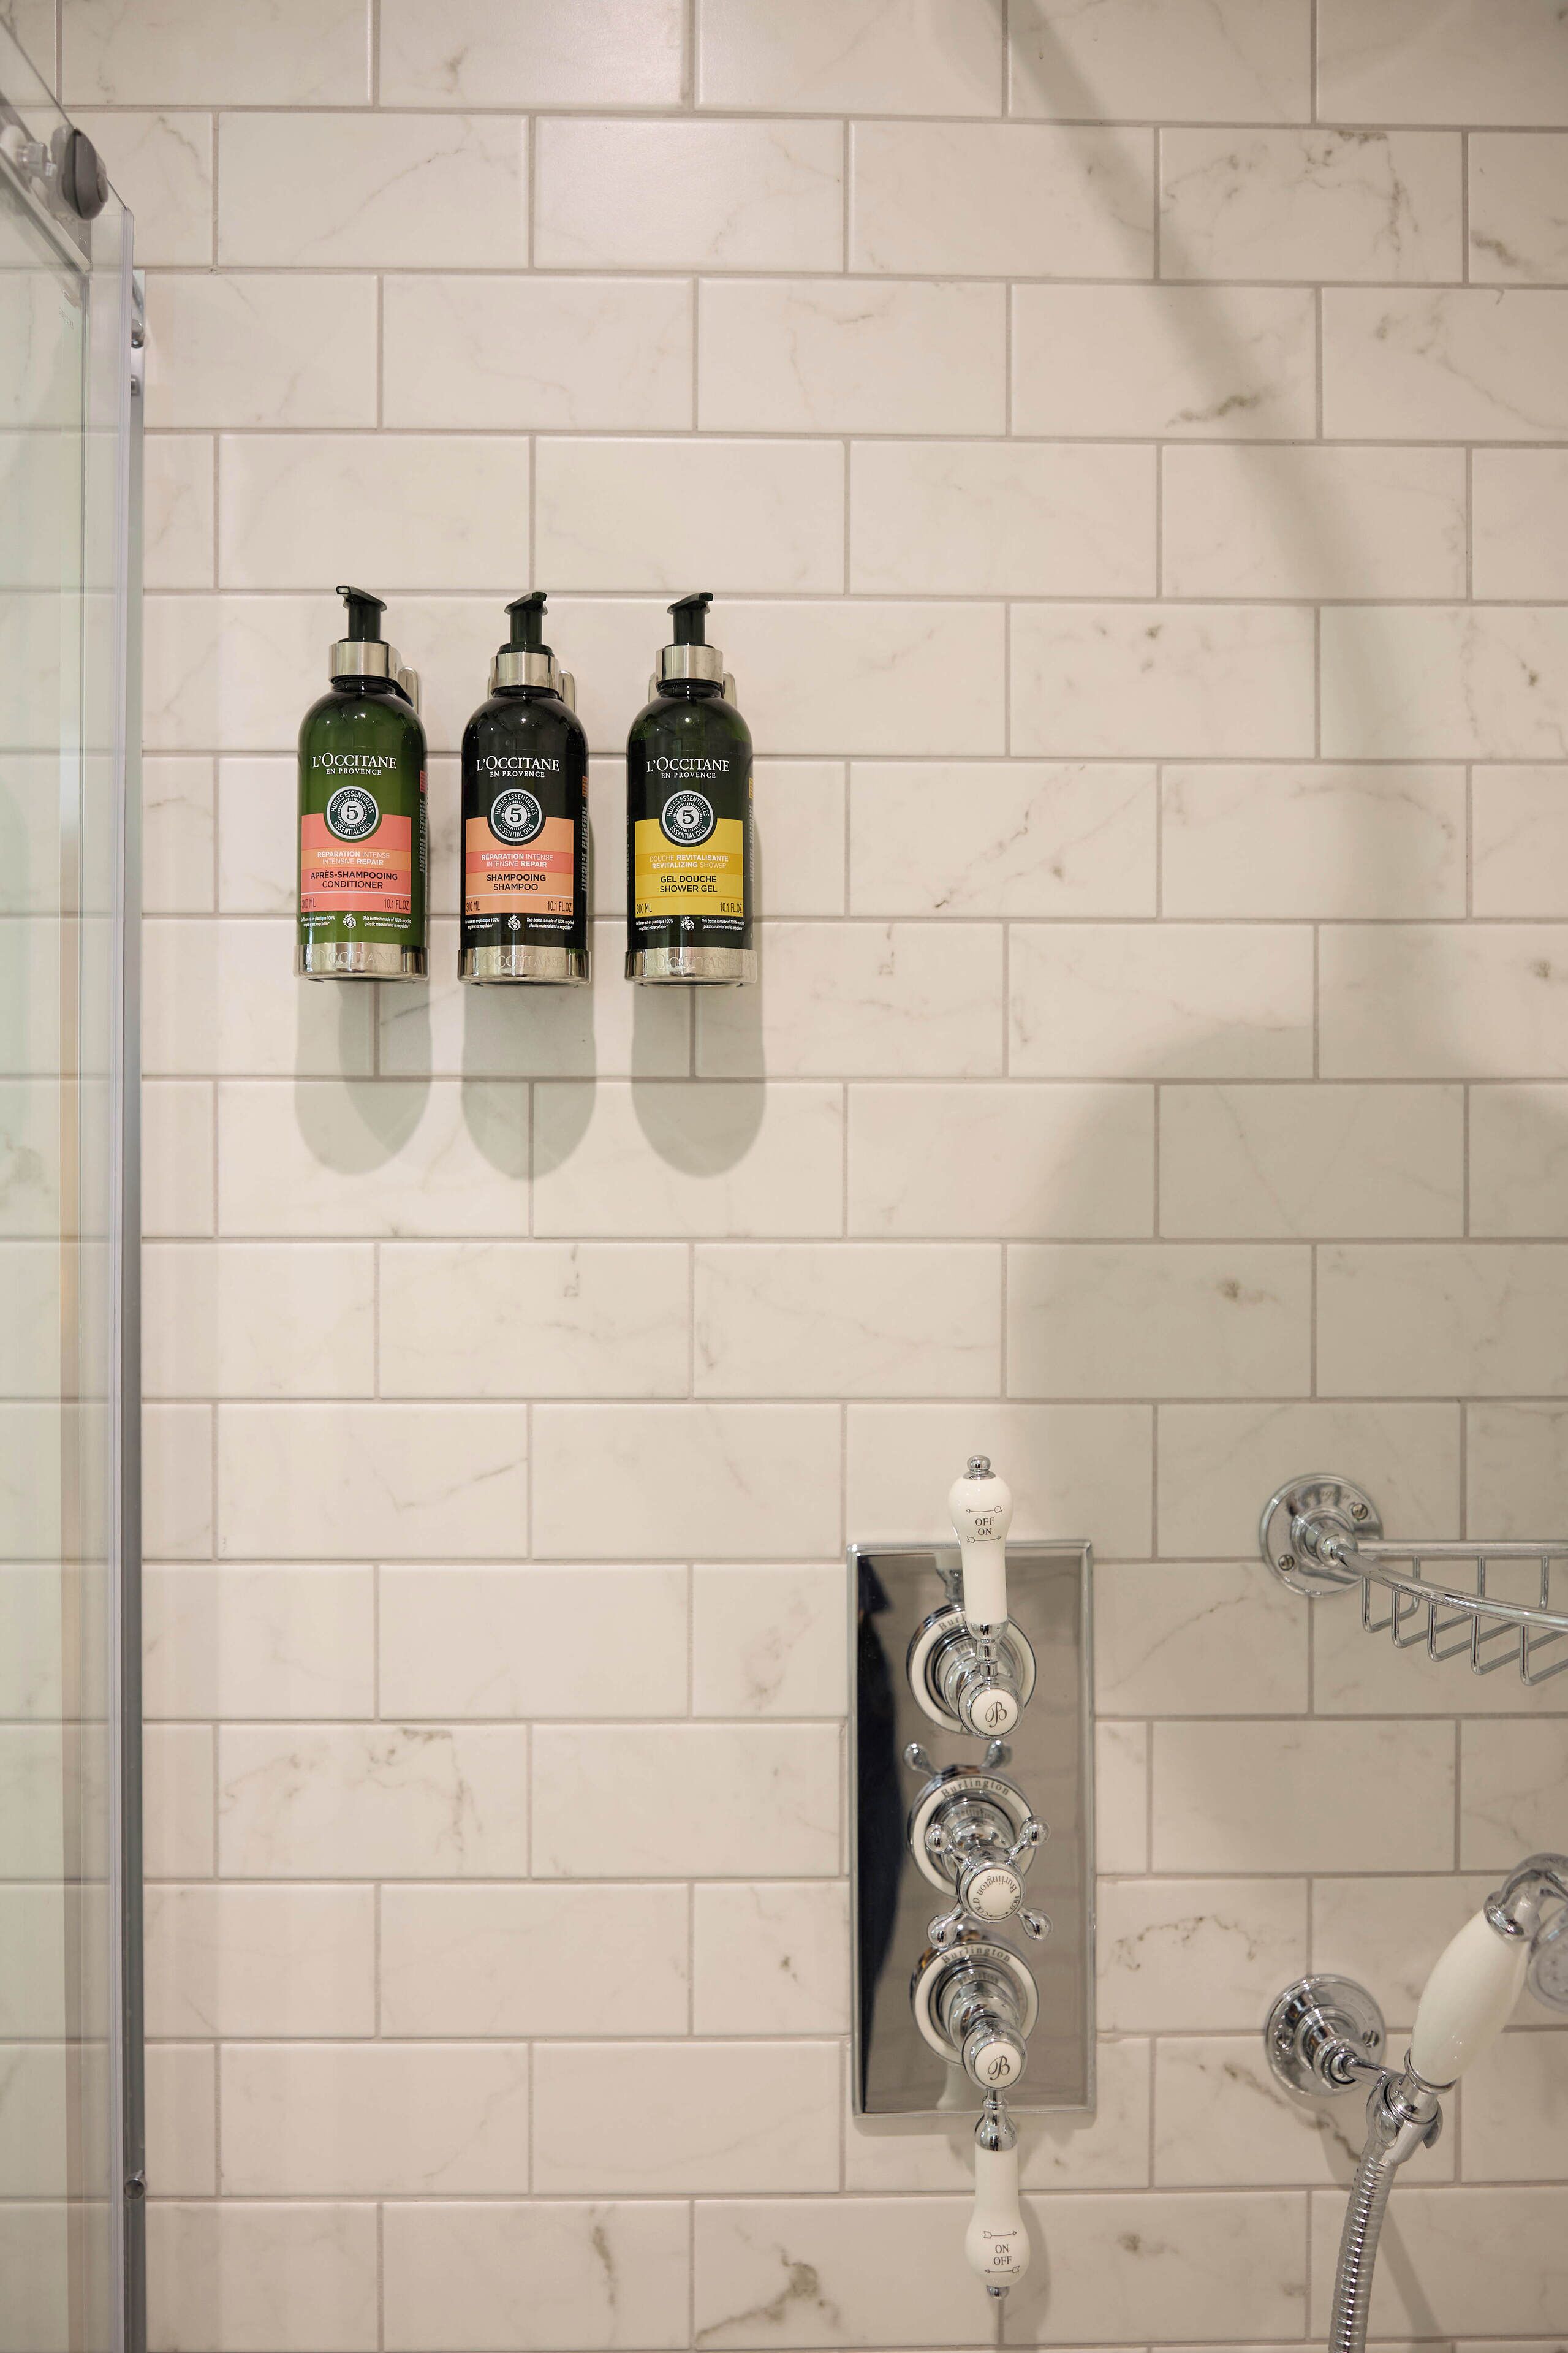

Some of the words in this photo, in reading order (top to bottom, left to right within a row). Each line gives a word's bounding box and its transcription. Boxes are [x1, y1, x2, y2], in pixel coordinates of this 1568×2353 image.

[312, 752, 397, 769] L'OCCITANE
[477, 756, 559, 771] L'OCCITANE
[646, 757, 730, 772] L'OCCITANE
[330, 794, 344, 813] HUILES
[344, 790, 374, 813] ESSENTIELLES
[494, 797, 508, 816] HUILES
[508, 793, 538, 816] ESSENTIELLES
[666, 798, 680, 817] HUILES
[680, 795, 710, 817] ESSENTIELLES
[346, 805, 358, 820] 5
[510, 808, 522, 822] 5
[682, 809, 694, 824] 5
[334, 820, 360, 835] ESSENTIAL
[360, 821, 371, 832] OILS
[498, 824, 524, 838] ESSENTIAL
[523, 824, 534, 835] OILS
[670, 825, 696, 839] ESSENTIAL
[695, 825, 706, 836] OILS
[311, 870, 398, 881] APRÈS-SHAMPOOING
[322, 881, 383, 889] CONDITIONER
[309, 898, 316, 908] ML
[384, 898, 394, 909] 10.1
[473, 900, 480, 911] ML
[547, 900, 557, 911] 10.1
[645, 902, 653, 913] ML
[720, 902, 729, 912] 10.1
[975, 1517, 994, 1526] OFF
[941, 1779, 1009, 1797] Burlington
[977, 1875, 1017, 1895] Burlington
[941, 1946, 1010, 1963] Burlington
[988, 2055, 1010, 2080] B
[995, 2243, 1009, 2254] ON
[993, 2256, 1012, 2265] OFF
